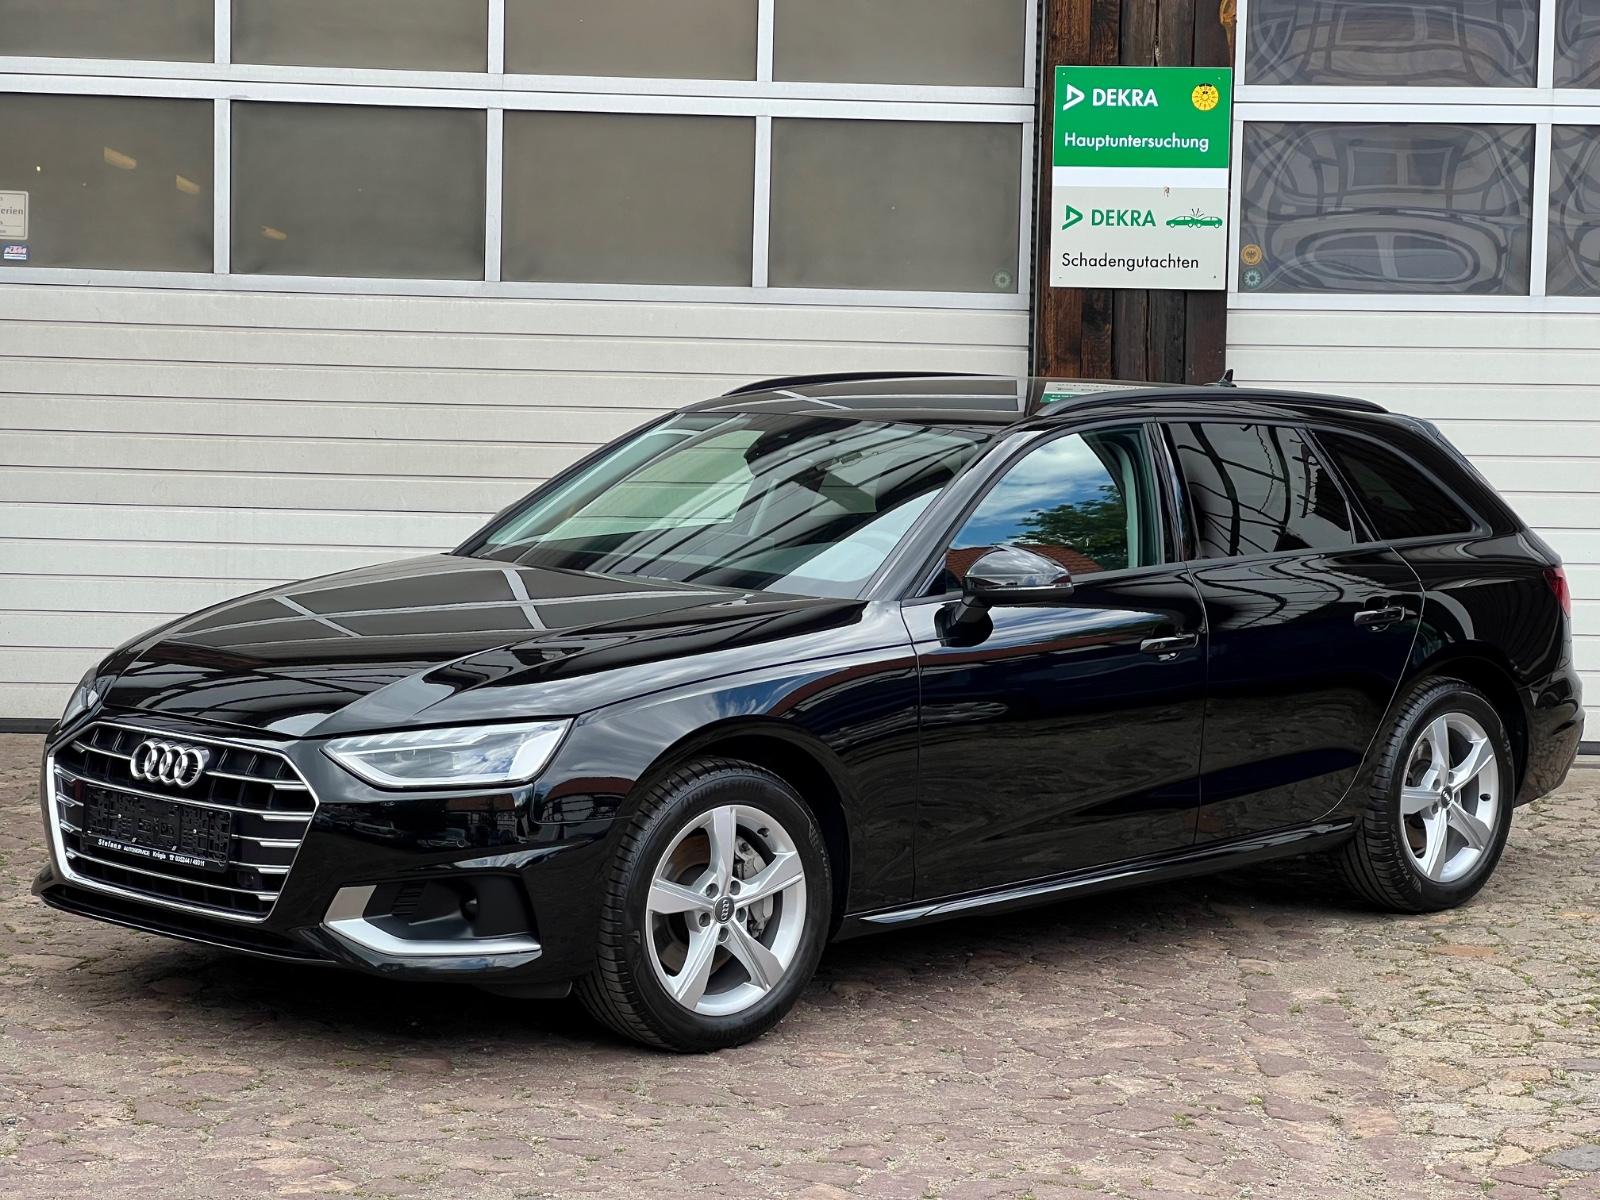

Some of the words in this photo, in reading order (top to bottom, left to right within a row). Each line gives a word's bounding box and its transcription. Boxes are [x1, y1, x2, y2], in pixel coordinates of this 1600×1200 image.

[1092, 88, 1159, 107] DEKRA
[1064, 132, 1209, 152] Hauptuntersuchung
[1091, 209, 1157, 227] DEKRA
[1062, 252, 1199, 271] Schadengutachten
